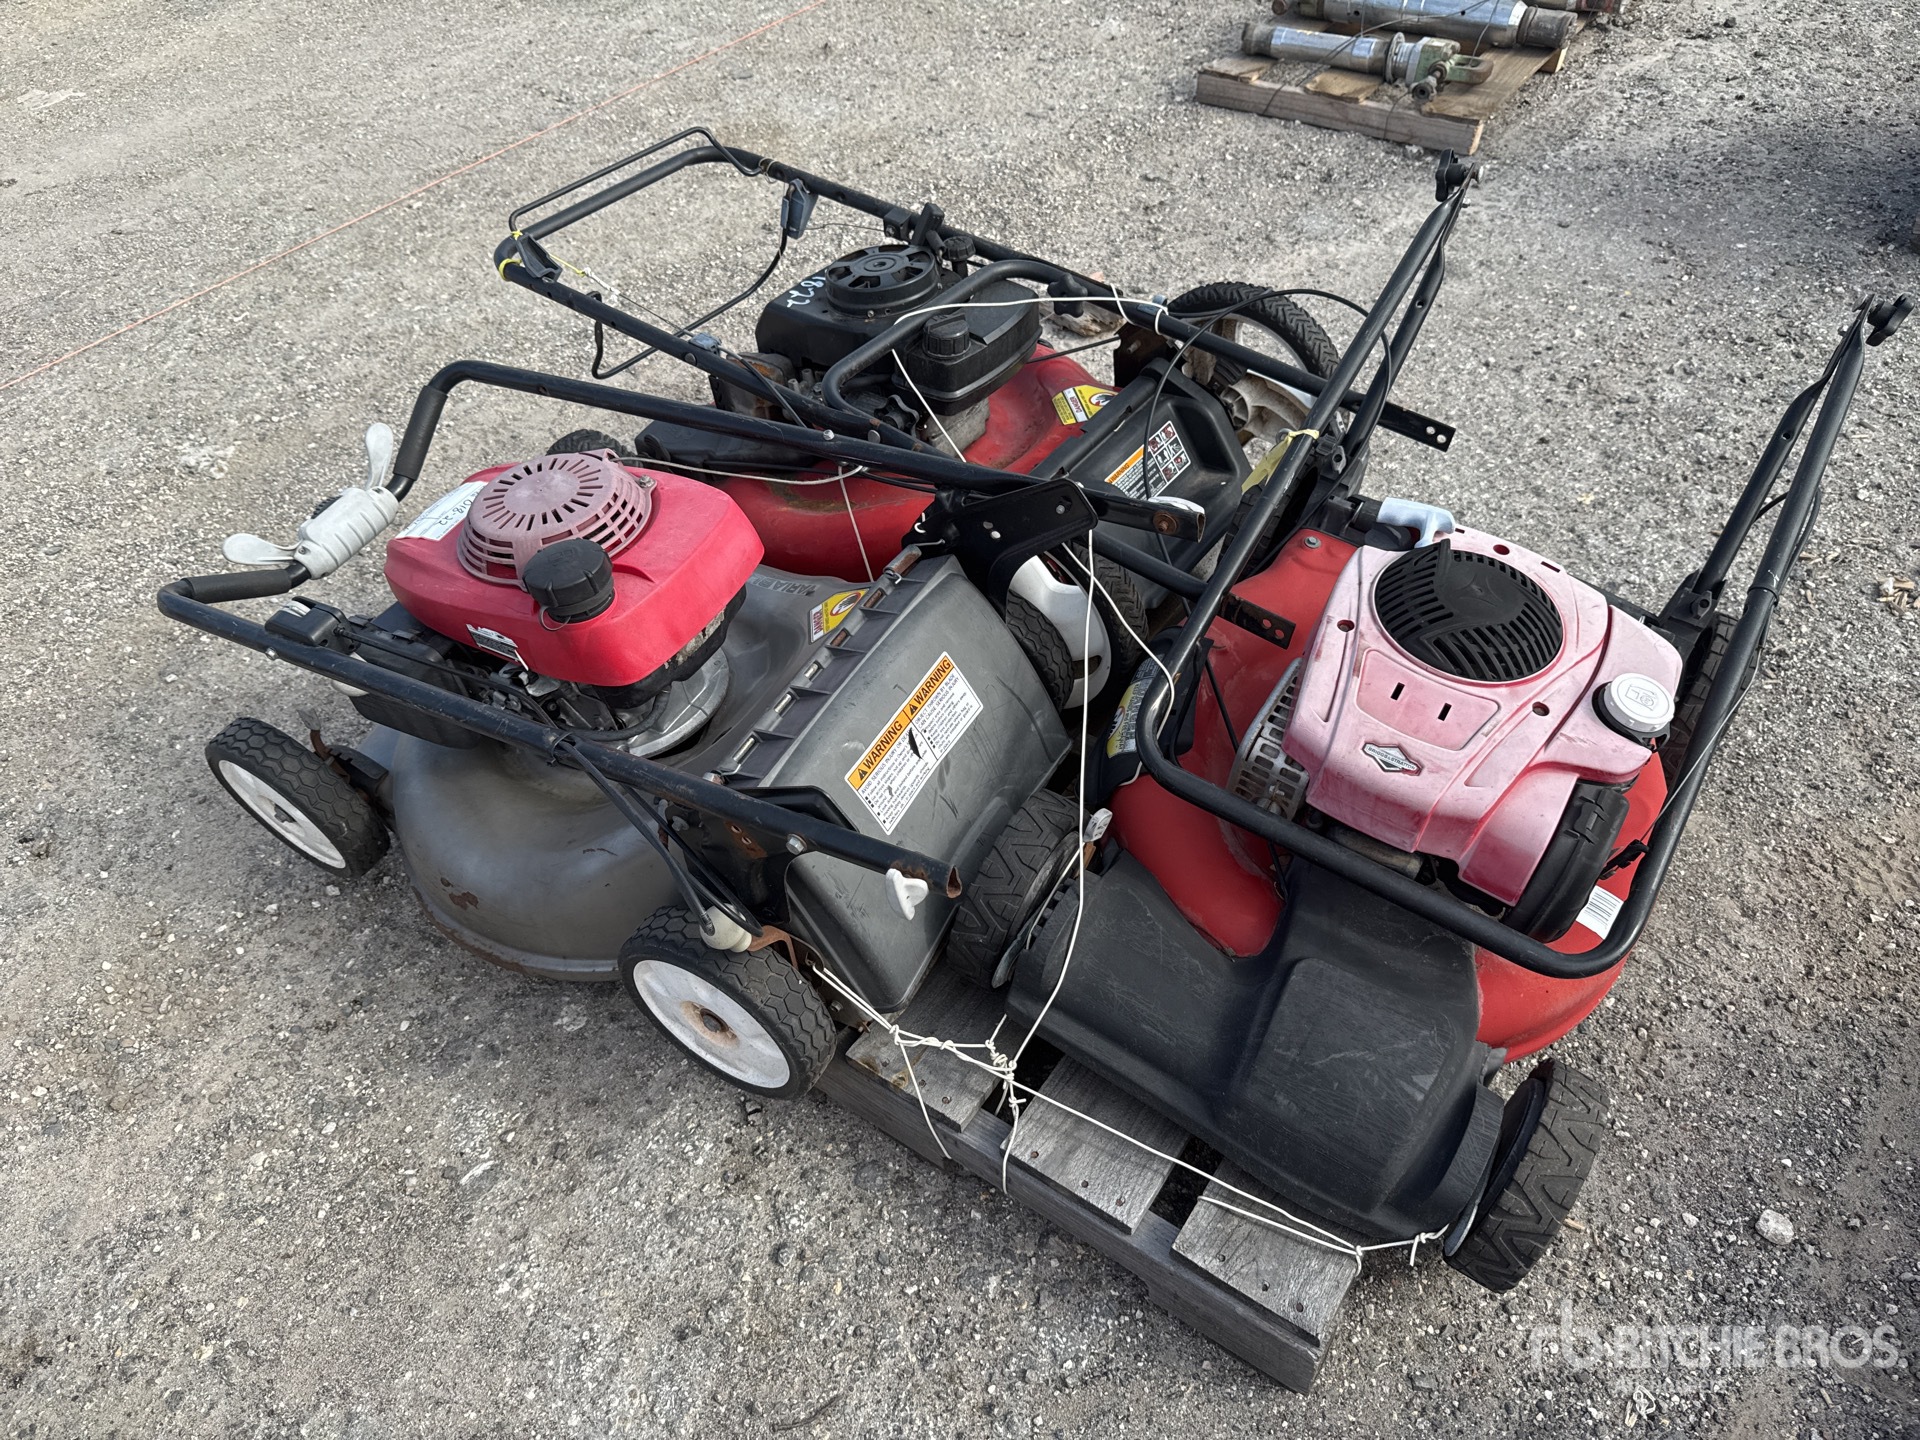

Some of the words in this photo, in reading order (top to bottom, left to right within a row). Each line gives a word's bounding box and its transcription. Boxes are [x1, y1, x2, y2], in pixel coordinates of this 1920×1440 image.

[751, 574, 818, 595] VARIABL
[914, 658, 951, 707] WARNING
[863, 719, 903, 772] WARNING
[1367, 746, 1388, 759] BRIGGS
[1390, 756, 1416, 770] STRATTON
